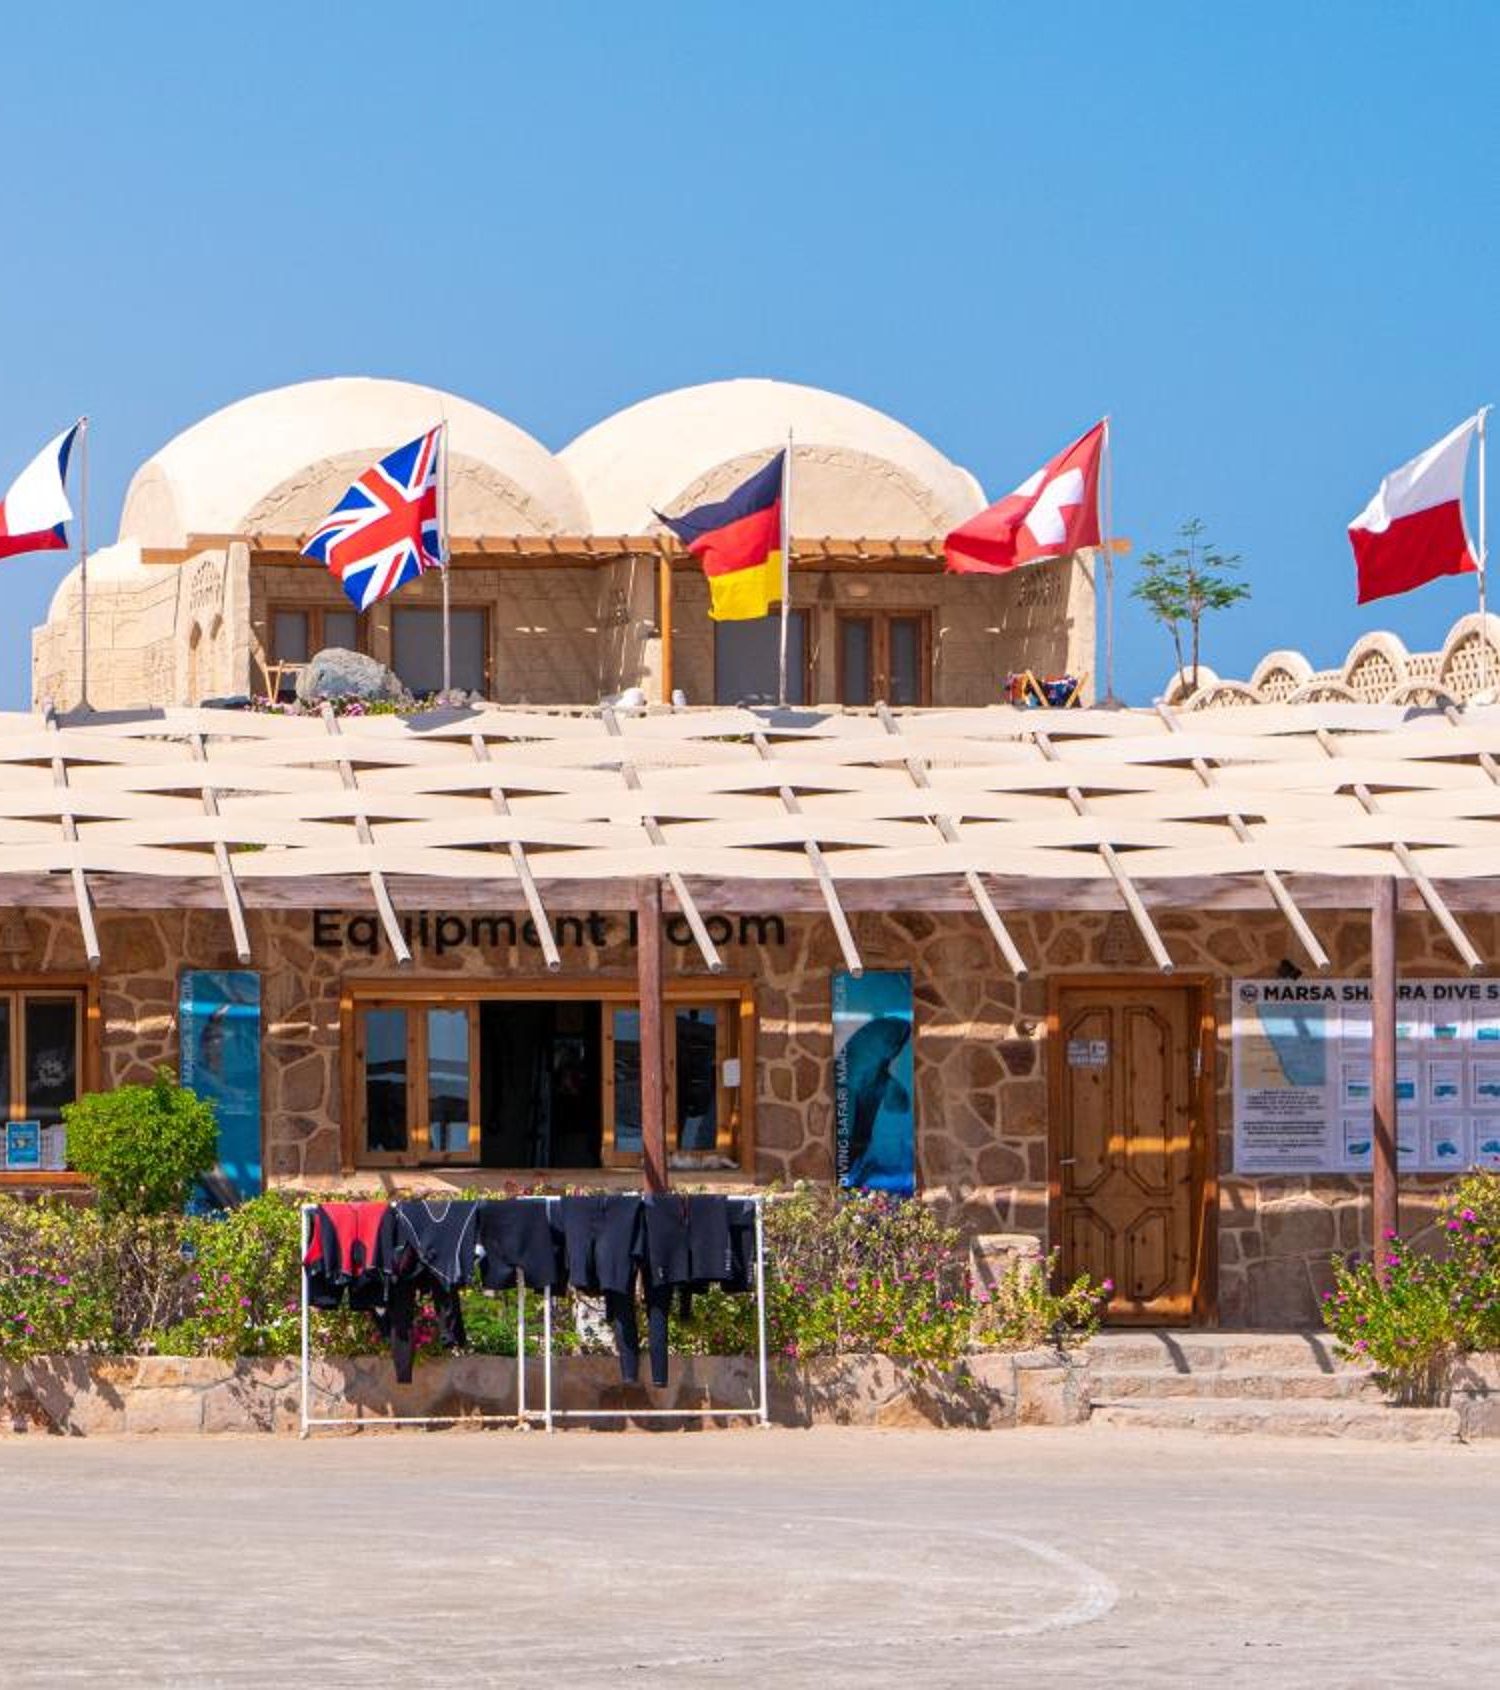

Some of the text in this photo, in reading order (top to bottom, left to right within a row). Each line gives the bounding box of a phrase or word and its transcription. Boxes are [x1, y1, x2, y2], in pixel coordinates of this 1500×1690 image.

[1263, 985, 1336, 1001] MARSA
[1342, 984, 1427, 1001] SHRA
[1433, 984, 1481, 1000] DIVE
[836, 1087, 849, 1136] SAFARI
[837, 1140, 849, 1187] DIVING
